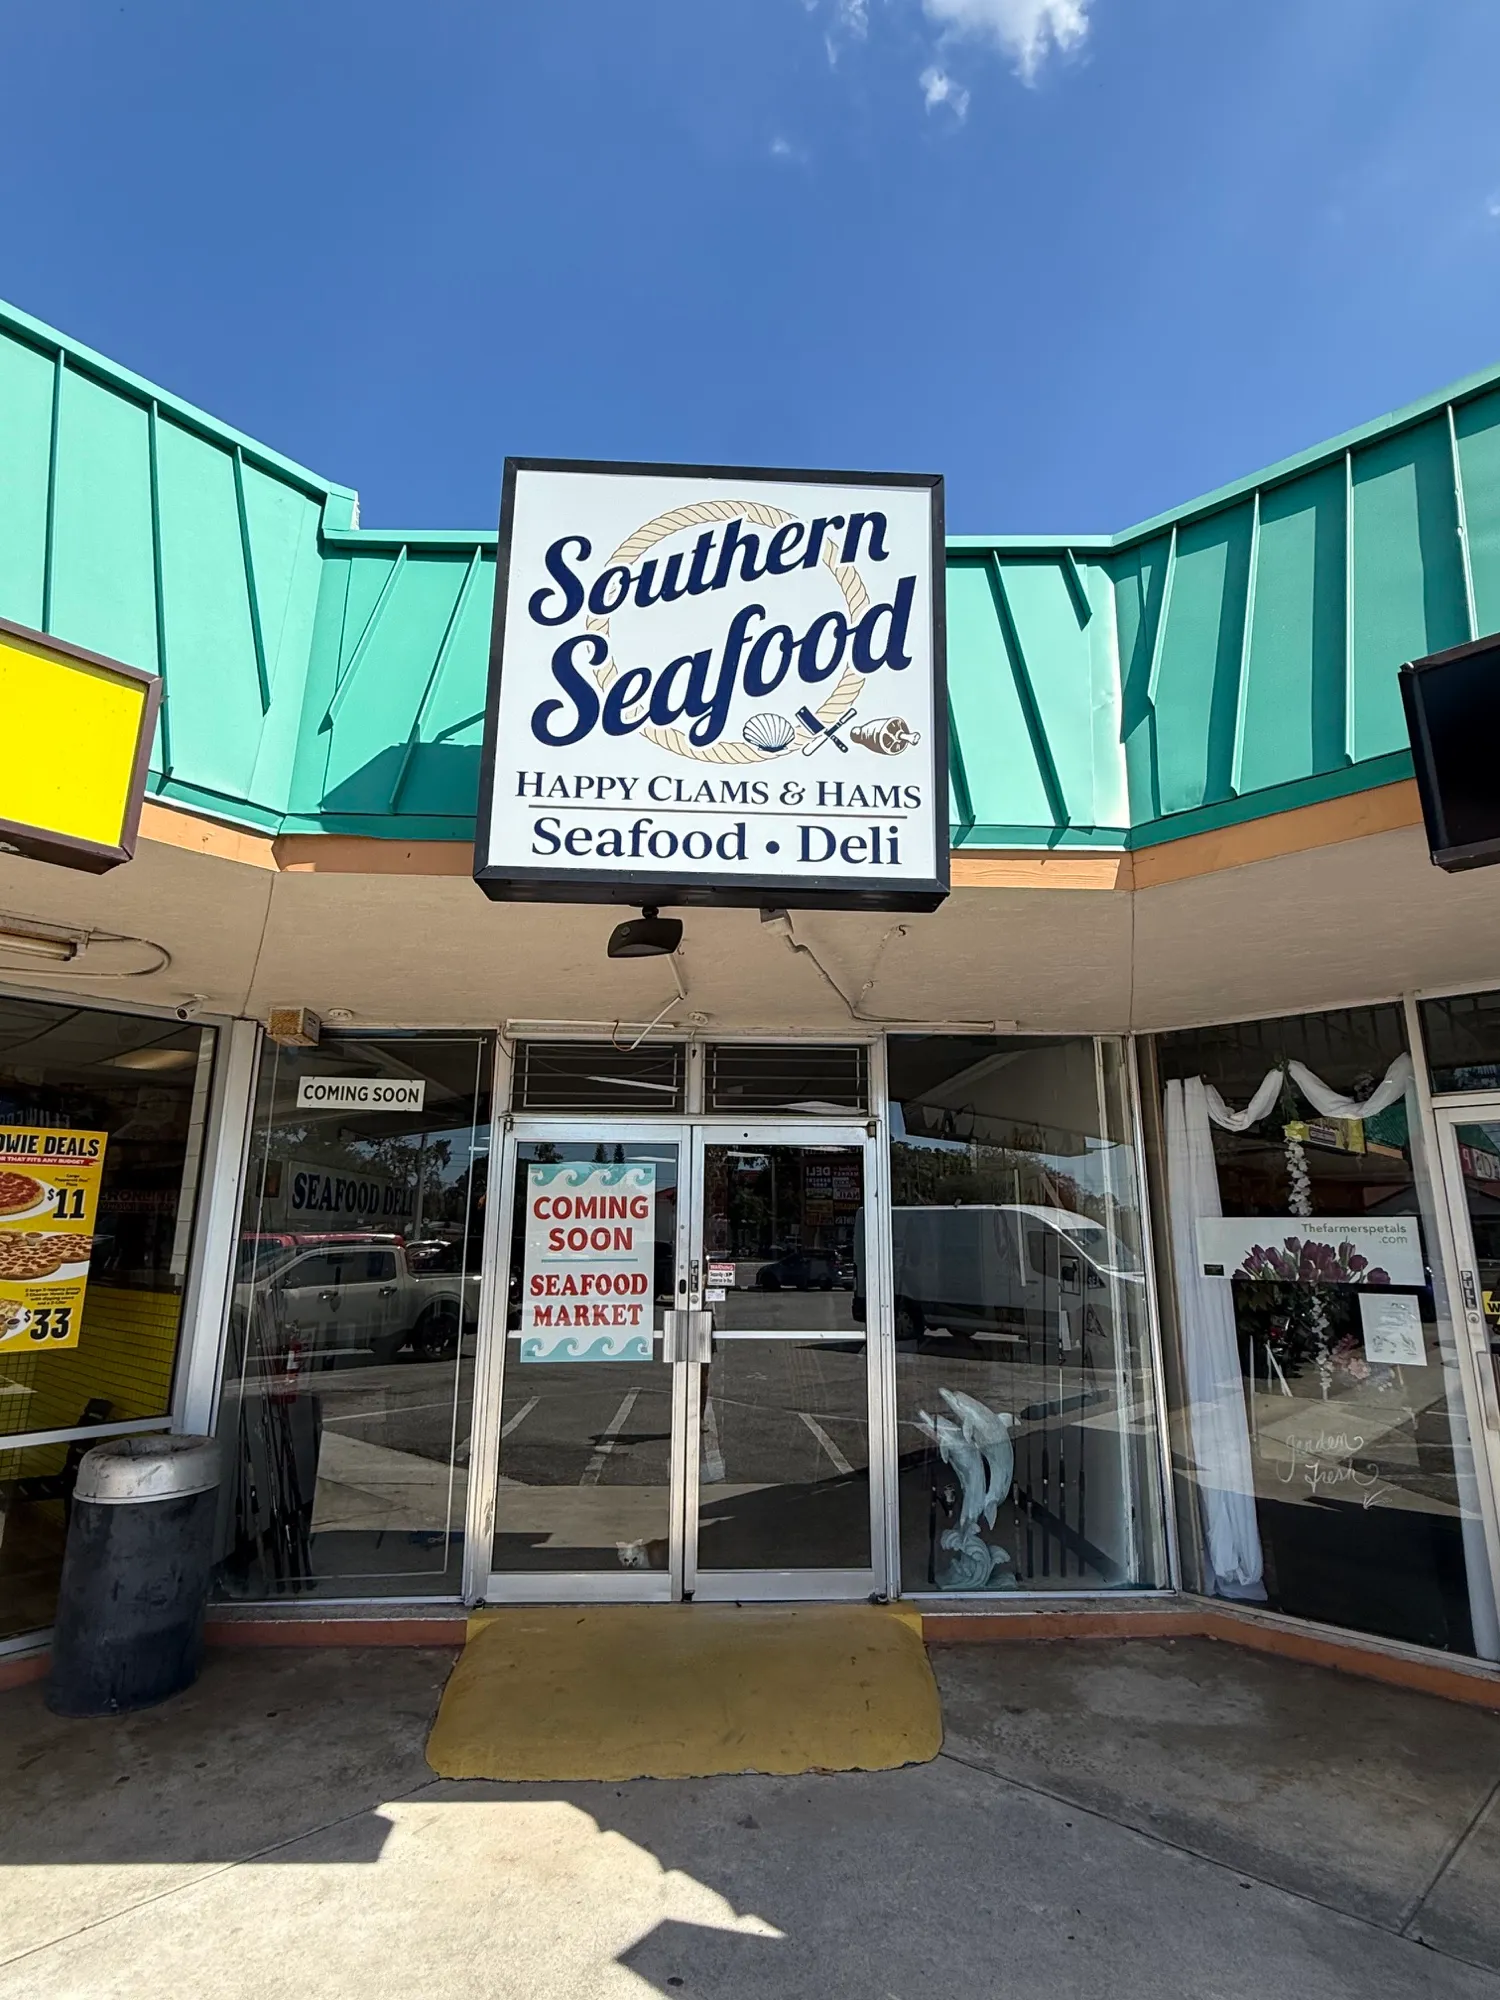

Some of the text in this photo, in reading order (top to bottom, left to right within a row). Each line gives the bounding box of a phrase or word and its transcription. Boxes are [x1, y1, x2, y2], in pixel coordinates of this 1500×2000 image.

[528, 511, 890, 627] Southern
[530, 575, 917, 747] Seafood
[515, 771, 921, 809] HAPPY CLAMS & HAMS
[532, 817, 902, 866] Seafood Deli
[304, 1085, 420, 1103] COMING SOON
[44, 1136, 100, 1156] DEALS
[47, 1188, 85, 1219] $11
[292, 1172, 415, 1217] SEAFOOD DELI
[533, 1195, 649, 1220] COMING
[548, 1227, 633, 1251] SOON
[1301, 1222, 1407, 1236] Thefarmerspetals
[1379, 1235, 1408, 1244] .com
[530, 1273, 648, 1297] SEAFOOD
[1462, 1271, 1475, 1308] PULL
[24, 1308, 72, 1340] $33
[533, 1304, 643, 1327] MARKET
